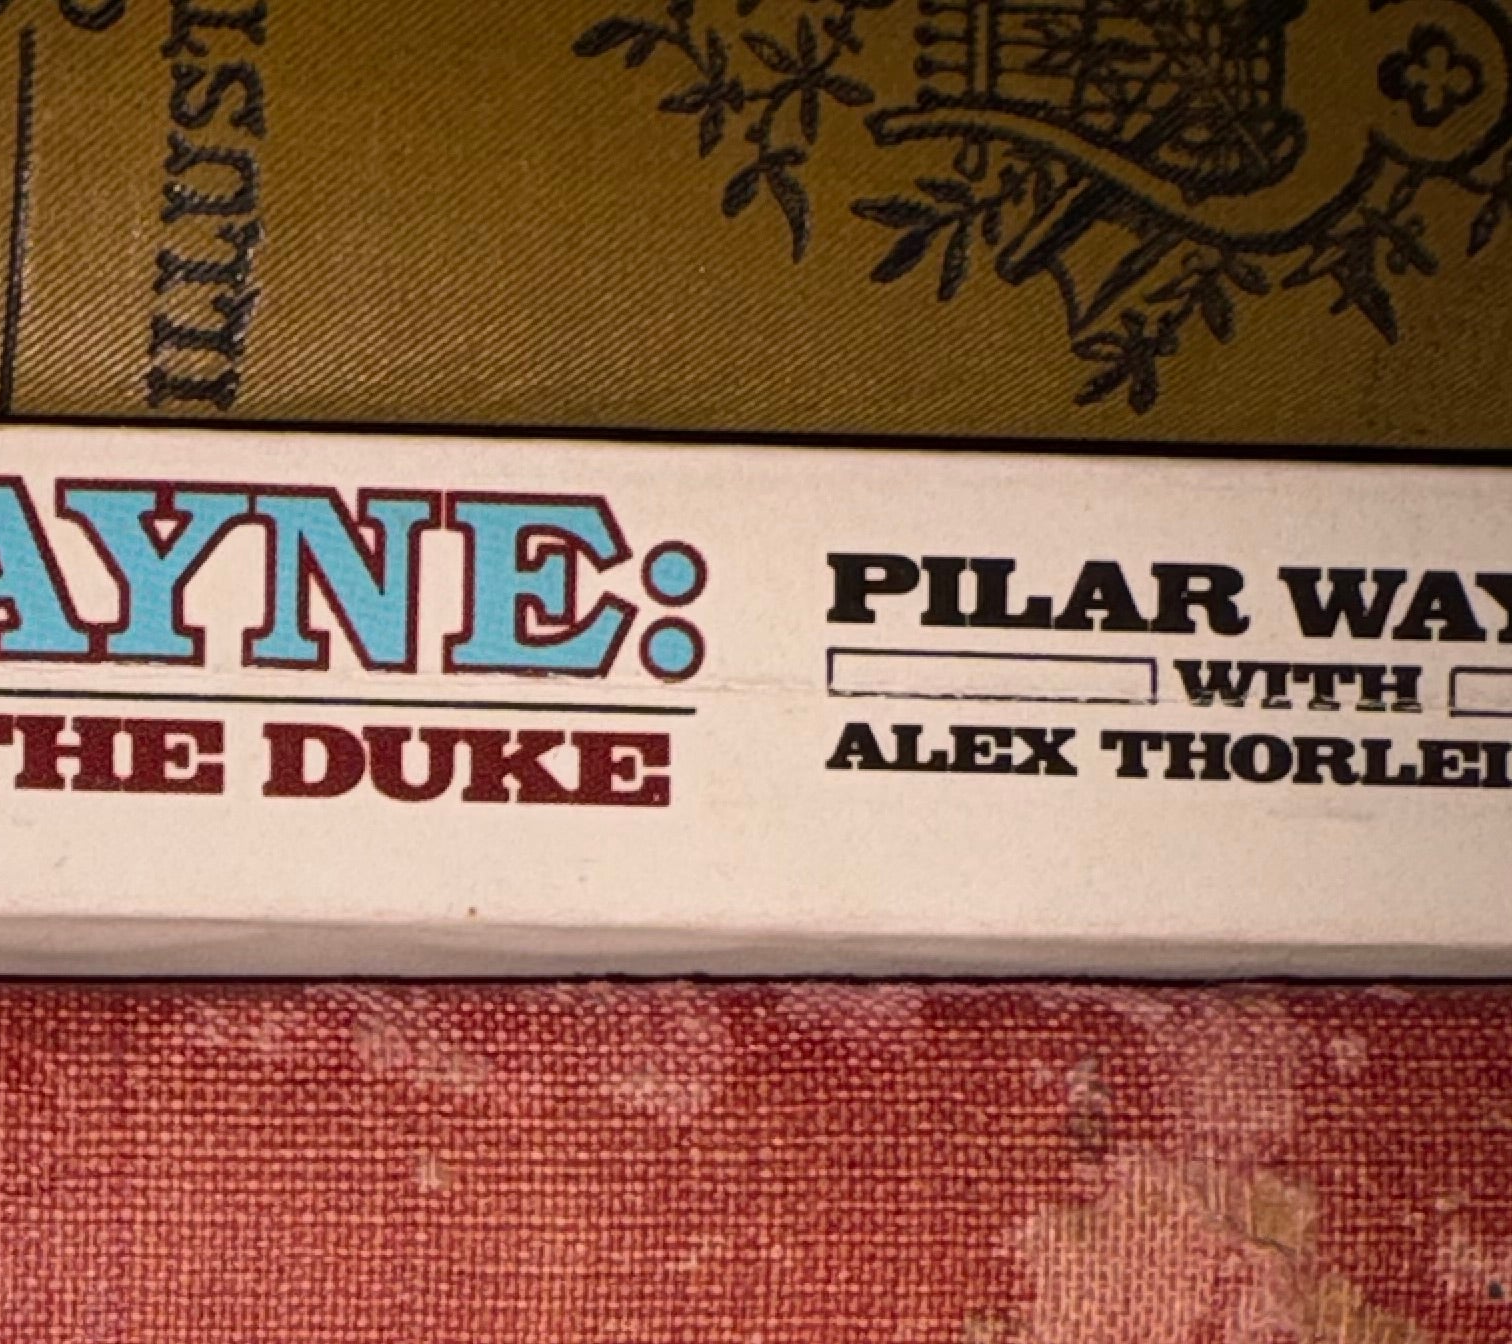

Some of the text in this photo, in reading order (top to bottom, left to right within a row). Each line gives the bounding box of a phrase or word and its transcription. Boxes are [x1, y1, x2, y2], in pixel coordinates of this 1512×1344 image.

[826, 552, 1250, 637] PILAR
[1174, 659, 1424, 714] WITH
[263, 722, 671, 808] DUKE
[825, 722, 1077, 777] ALEX
